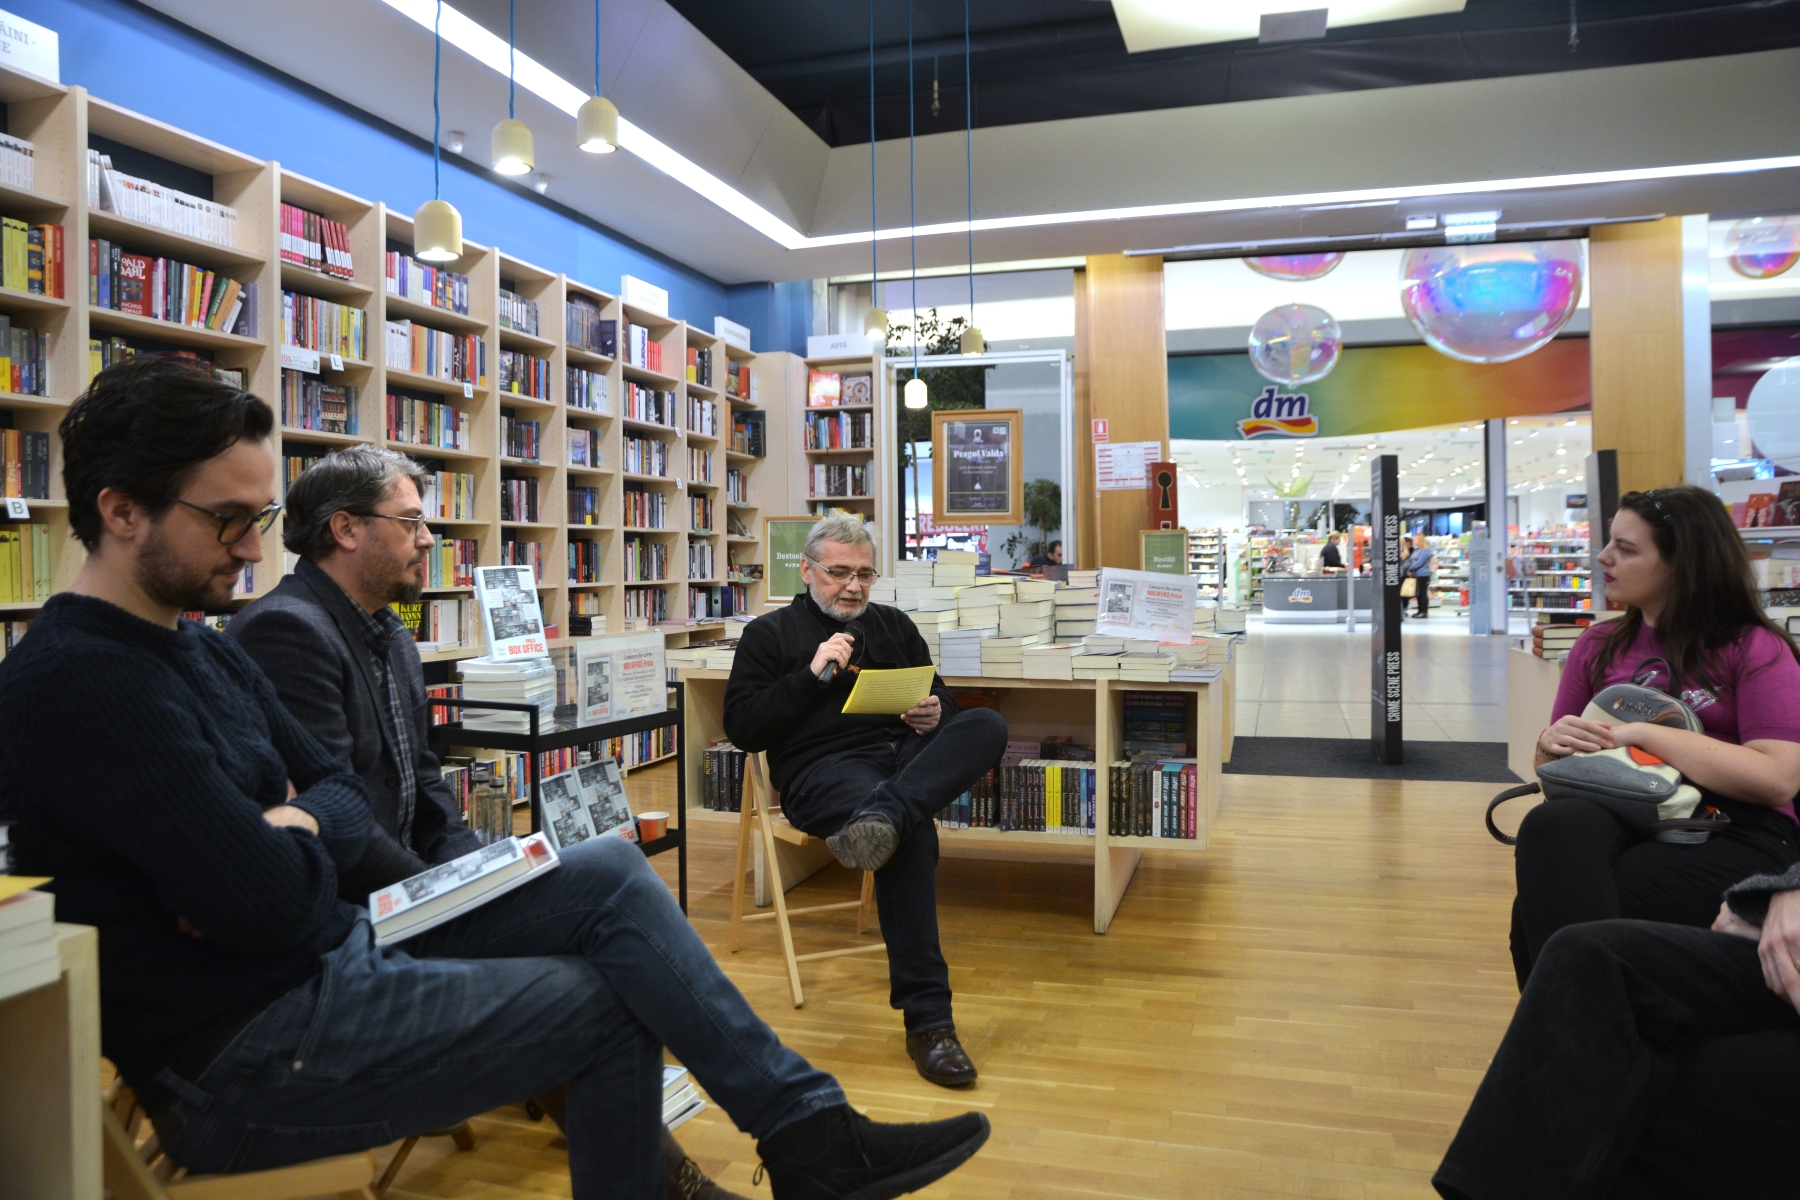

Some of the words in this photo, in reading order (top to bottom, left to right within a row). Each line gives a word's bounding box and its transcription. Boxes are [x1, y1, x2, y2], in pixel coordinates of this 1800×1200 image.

[121, 257, 146, 269] OALD
[1253, 388, 1306, 419] dm
[953, 449, 980, 460] Pragul
[981, 449, 1004, 458] Vaida
[12, 502, 24, 514] B
[1384, 515, 1398, 538] PRESS
[1385, 539, 1399, 562] SCENE
[1385, 562, 1399, 586] CRIME
[400, 603, 422, 613] KURT
[508, 645, 522, 655] BOX
[522, 643, 545, 654] OFFICE
[1386, 651, 1400, 675] PRESS
[1387, 675, 1400, 698] SCENE
[1387, 699, 1400, 722] CRIME
